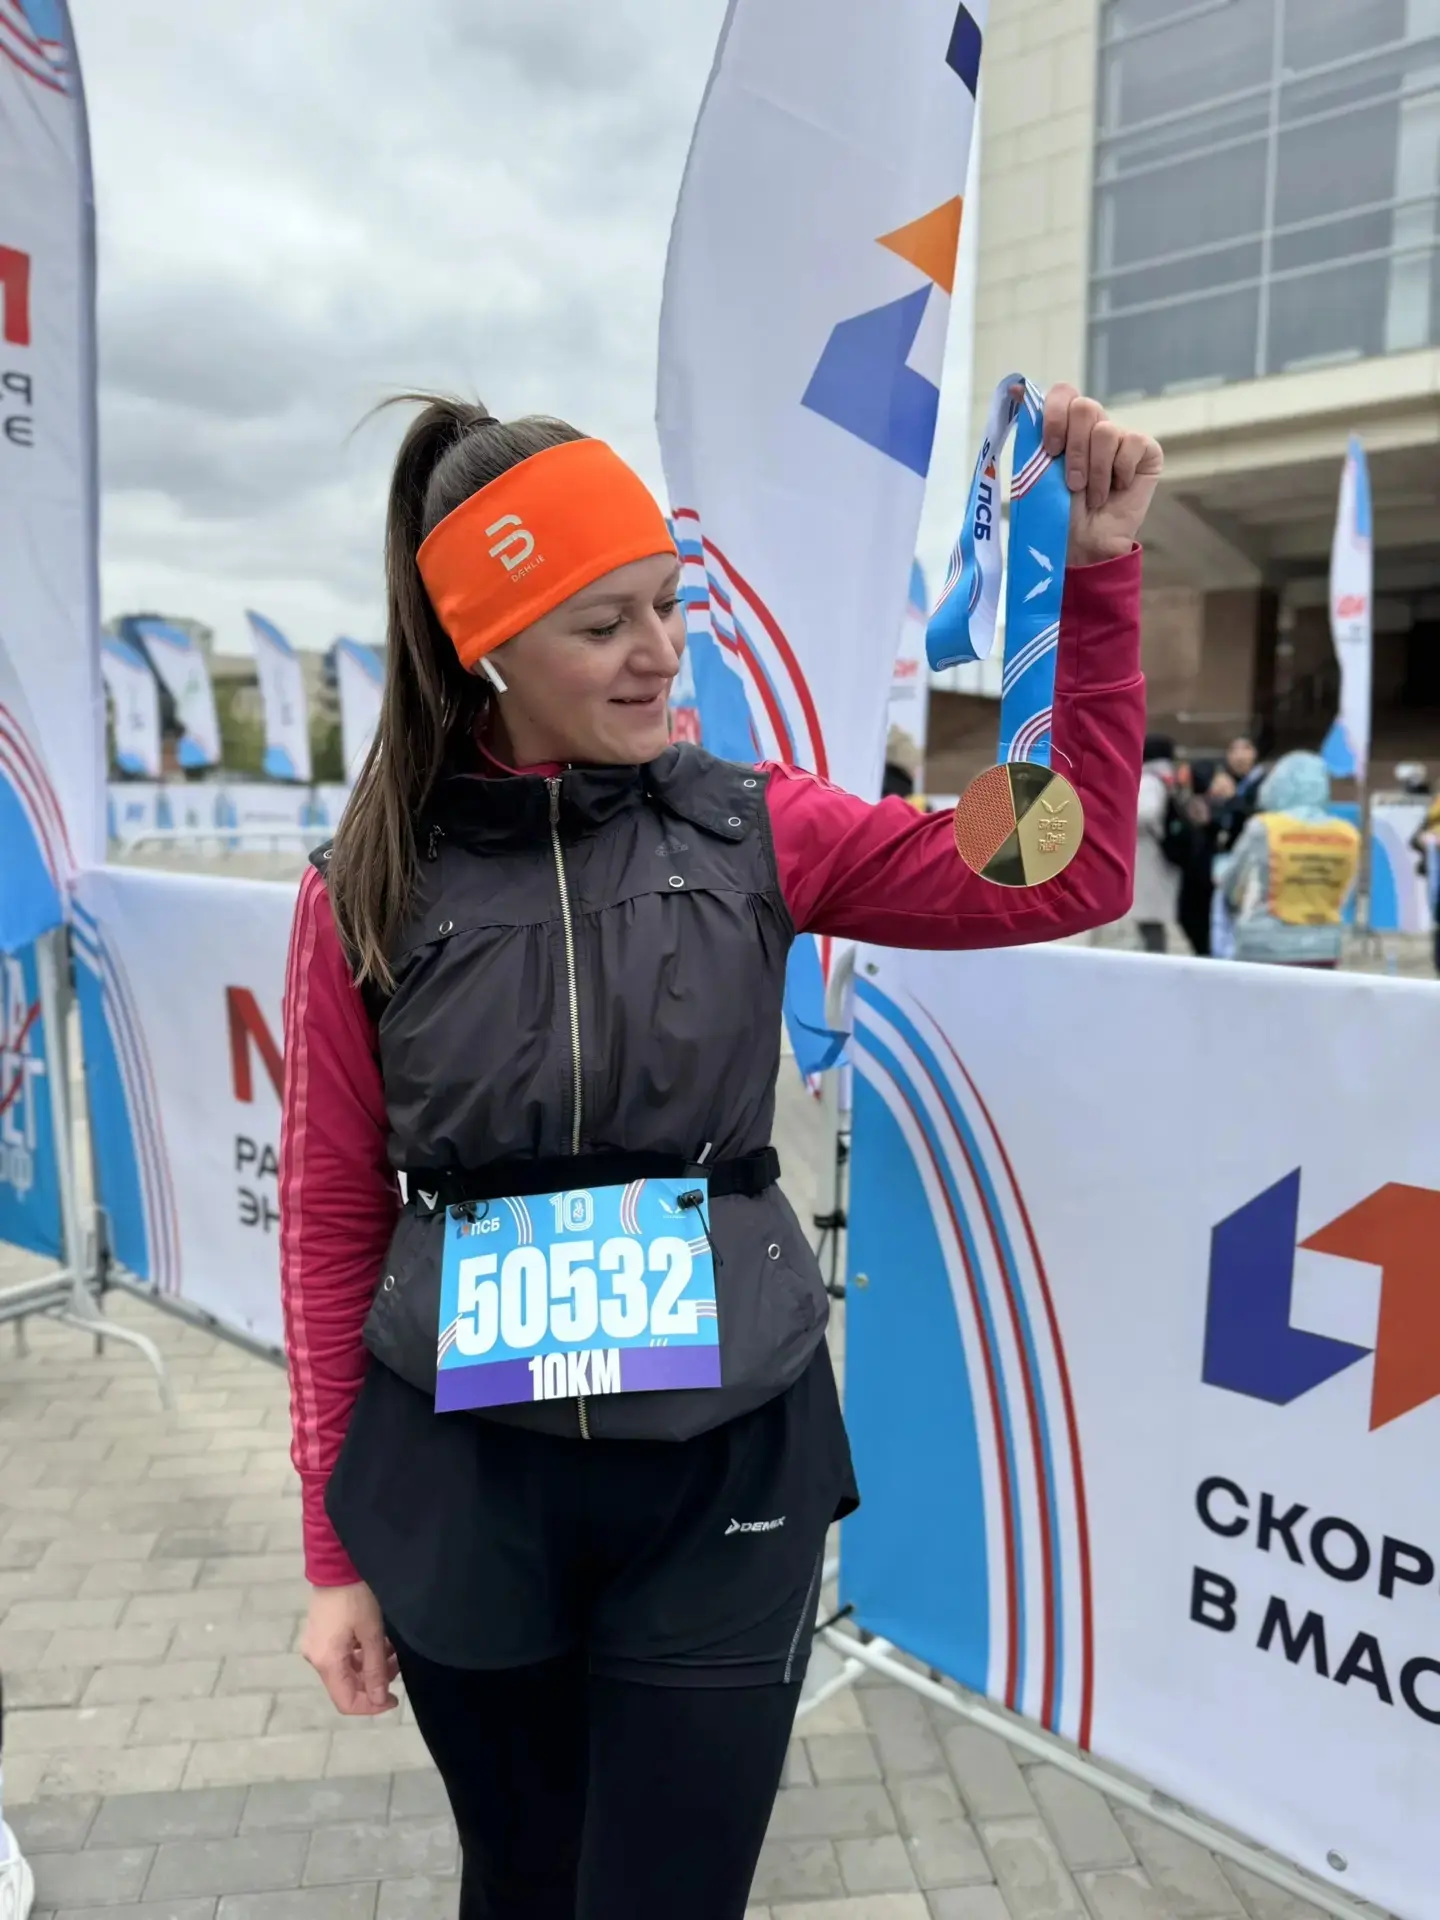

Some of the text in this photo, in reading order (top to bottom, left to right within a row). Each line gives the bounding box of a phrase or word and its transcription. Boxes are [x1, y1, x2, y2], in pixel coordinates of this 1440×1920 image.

[973, 482, 992, 541] ПСБ
[470, 1217, 501, 1236] ПСБ
[548, 1189, 594, 1234] 10
[456, 1237, 699, 1356] 50532
[1195, 1475, 1440, 1601] СКОР
[1190, 1564, 1238, 1634] В
